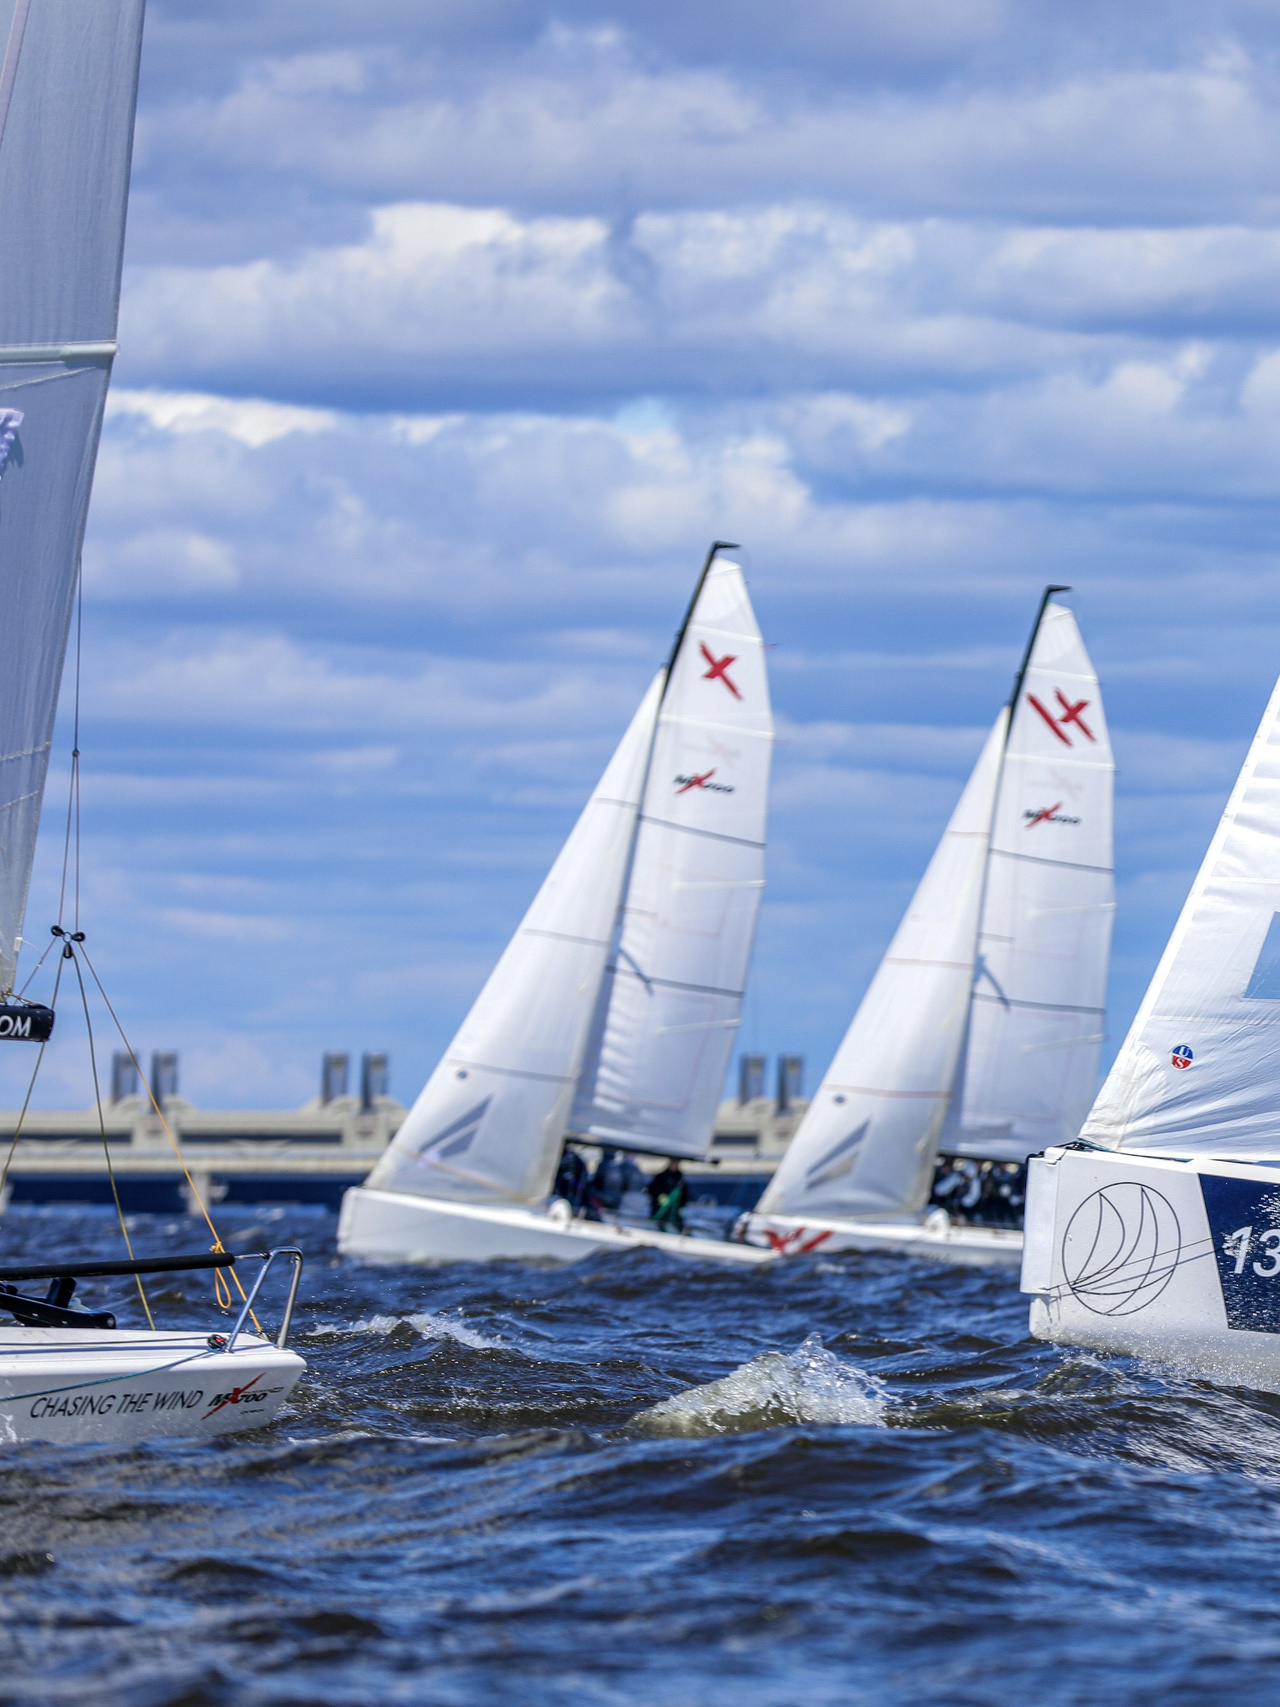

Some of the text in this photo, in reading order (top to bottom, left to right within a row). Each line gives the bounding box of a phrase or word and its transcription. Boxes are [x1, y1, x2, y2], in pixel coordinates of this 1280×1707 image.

[30, 1390, 204, 1418] CHASING THE WIND
